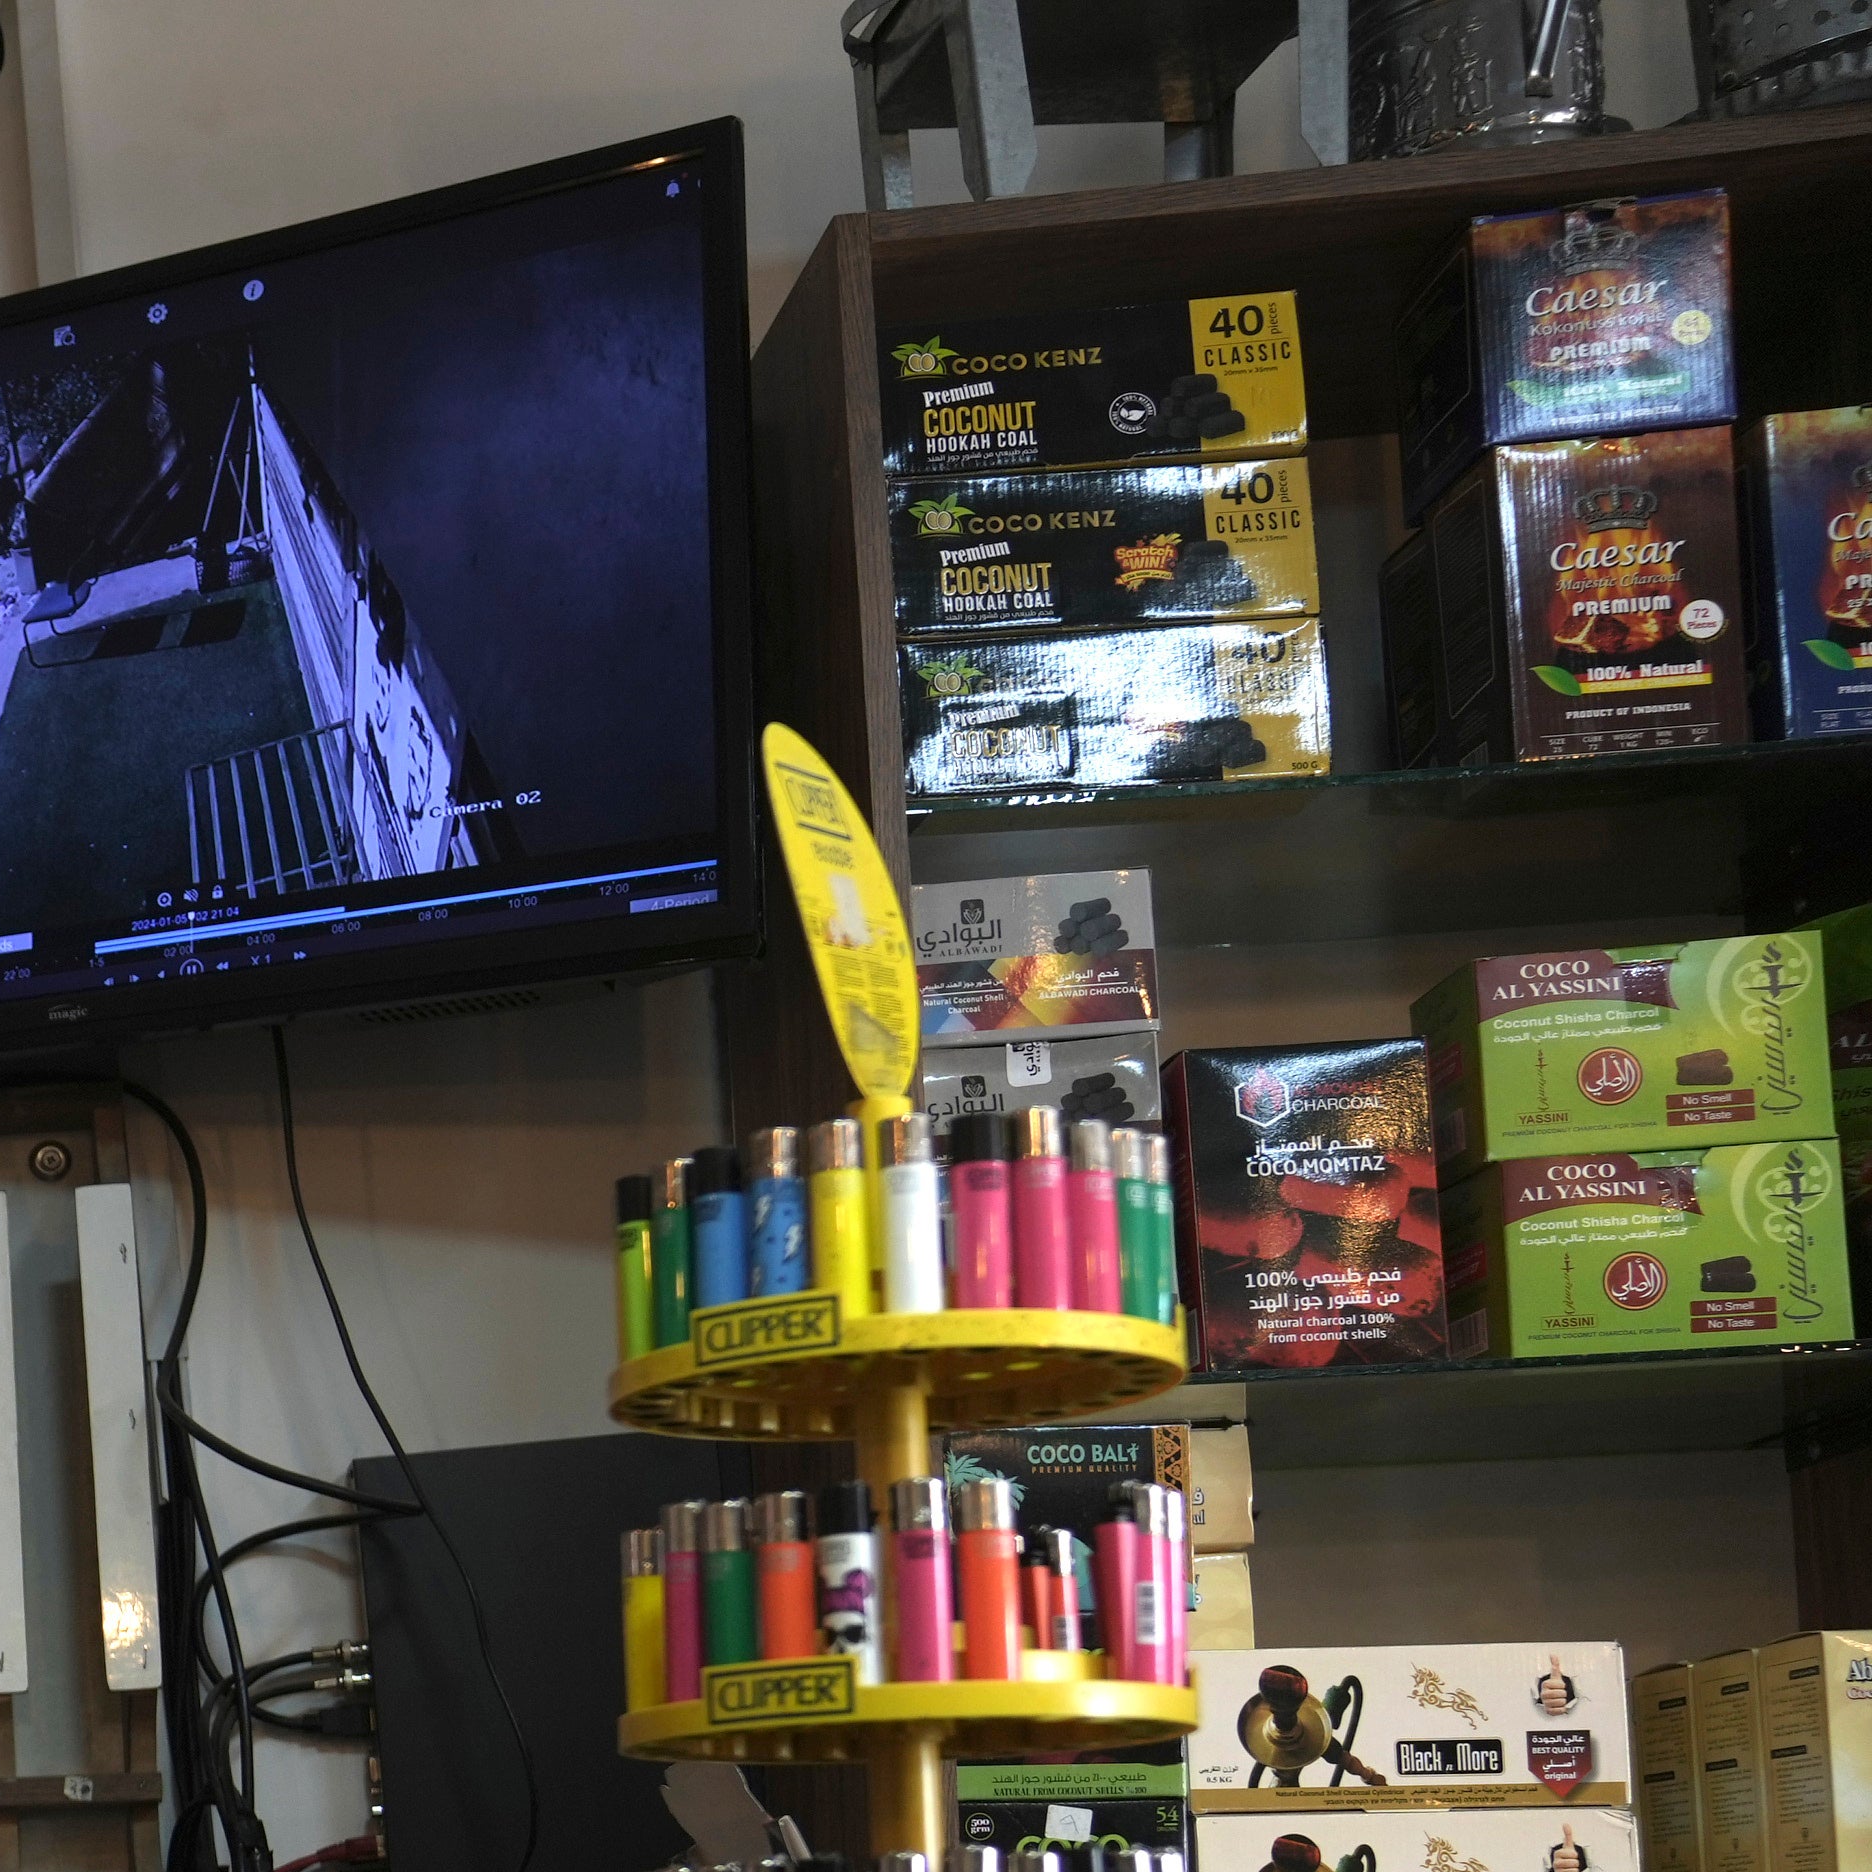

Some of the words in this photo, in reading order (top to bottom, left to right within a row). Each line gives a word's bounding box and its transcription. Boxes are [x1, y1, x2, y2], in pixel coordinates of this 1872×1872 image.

[1525, 278, 1668, 317] Caesar
[1209, 305, 1264, 339] 40
[1269, 302, 1278, 335] pieces
[952, 353, 1027, 376] COCO
[1034, 347, 1102, 368] KENZ
[1204, 340, 1292, 367] CLASSIC
[923, 380, 994, 408] Premium
[923, 401, 1036, 437] COCONUT
[926, 435, 991, 454] HOOKAH
[998, 430, 1037, 447] COAL
[968, 513, 1042, 535] COCO
[1050, 509, 1116, 530] KENZ
[1216, 510, 1301, 535] CLASSIC
[1115, 544, 1174, 561] Scratch
[1550, 539, 1687, 572] Caesar
[941, 563, 1052, 596] COCONUT
[1556, 576, 1617, 594] Majestic
[1620, 568, 1683, 586] Charcoal
[1572, 594, 1671, 617] PREMIUM
[1692, 607, 1710, 619] 72
[1687, 619, 1717, 630] Pieces
[1586, 665, 1632, 682] 100%
[1639, 660, 1703, 678] Natural
[1565, 707, 1613, 720] PRODUCT
[1617, 706, 1630, 716] OF
[1632, 702, 1692, 715] INDONESIA
[429, 800, 504, 820] Camera
[514, 790, 542, 806] 02
[917, 919, 1002, 958] البوادي
[939, 945, 1003, 958] ALBAWADI
[1097, 967, 1120, 982] فحم
[1519, 960, 1590, 979] COCO
[1038, 988, 1088, 1000] ALBAWADI
[1089, 985, 1140, 996] CHARCOAL
[1493, 985, 1525, 1001] AL
[1527, 976, 1621, 997] YASSINI
[923, 998, 951, 1007] Natural
[953, 995, 983, 1004] Coconut
[984, 994, 1004, 1002] Shell
[948, 1005, 981, 1014] Charcoal
[48, 1005, 89, 1022] magic
[1493, 1015, 1552, 1030] Coconut
[1555, 1010, 1602, 1025] Shisha
[1292, 1096, 1383, 1113] CHARCOAL
[1683, 1095, 1698, 1105] No
[1701, 1093, 1732, 1104] Smell
[1519, 1112, 1569, 1125] YASSINI
[1684, 1111, 1701, 1122] No
[1703, 1110, 1732, 1120] Taste
[1246, 1157, 1296, 1177] COCO
[1302, 1156, 1385, 1173] MOMTAZ
[1546, 1163, 1616, 1181] COCO
[1519, 1187, 1551, 1202] AL
[1556, 1180, 1646, 1199] YASSINI
[1244, 1271, 1297, 1288] 100%
[1302, 1269, 1363, 1290] طبيعي
[1367, 1267, 1402, 1283] فحم
[1249, 1292, 1288, 1312] الهند
[1293, 1295, 1323, 1311] جوز
[1327, 1289, 1371, 1311] قشور
[1376, 1294, 1400, 1306] من
[705, 1306, 830, 1354] CLIPPER
[1258, 1318, 1303, 1330] Natural
[1306, 1315, 1357, 1326] charcoal
[1360, 1313, 1395, 1324] 100%
[1268, 1332, 1297, 1344] from
[1300, 1330, 1349, 1342] coconut
[1351, 1328, 1387, 1340] shells
[1026, 1444, 1086, 1465] COCO
[1031, 1465, 1083, 1474] PREMIUM
[1088, 1464, 1138, 1474] QUALITY
[716, 1673, 843, 1713] CLIPPER
[1400, 1743, 1441, 1773] Black
[1457, 1742, 1498, 1771] More
[1532, 1746, 1550, 1754] BEST
[1551, 1746, 1585, 1755] QUALITY
[1544, 1772, 1577, 1782] original
[1156, 1806, 1179, 1823] 54
